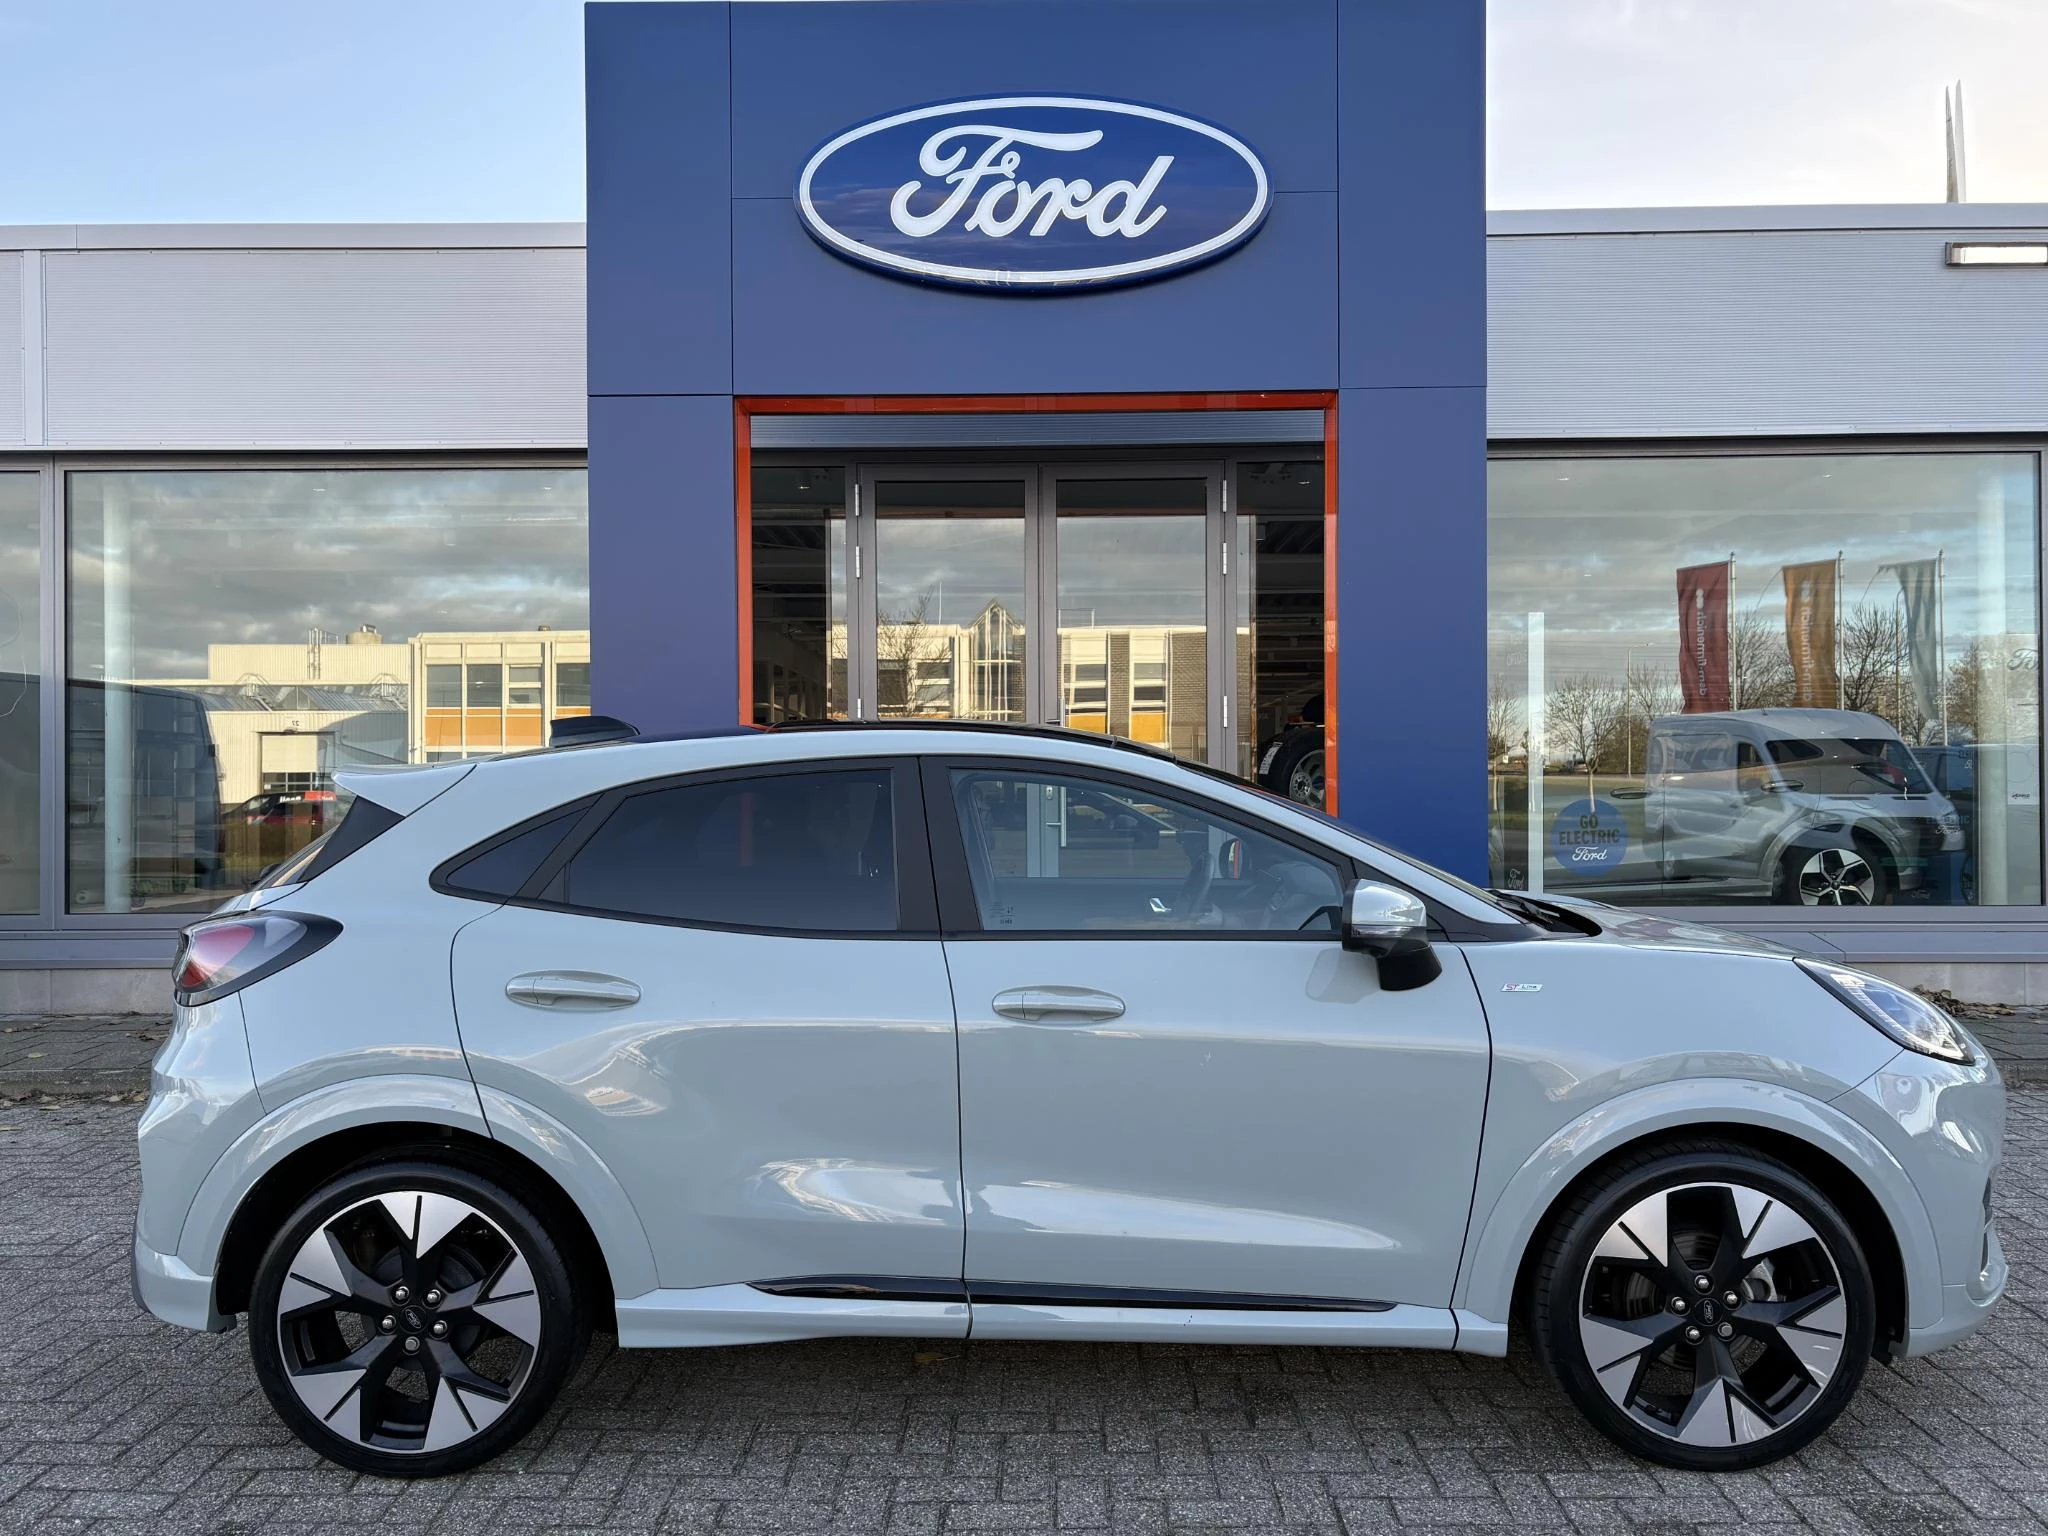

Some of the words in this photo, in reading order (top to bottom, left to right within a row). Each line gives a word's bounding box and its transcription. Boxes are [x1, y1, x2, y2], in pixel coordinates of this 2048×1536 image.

[890, 124, 1175, 238] Ford
[2007, 648, 2040, 671] Fo
[1580, 815, 1598, 829] GO
[1559, 829, 1620, 845] ELECTRIC
[1572, 846, 1607, 861] Ford
